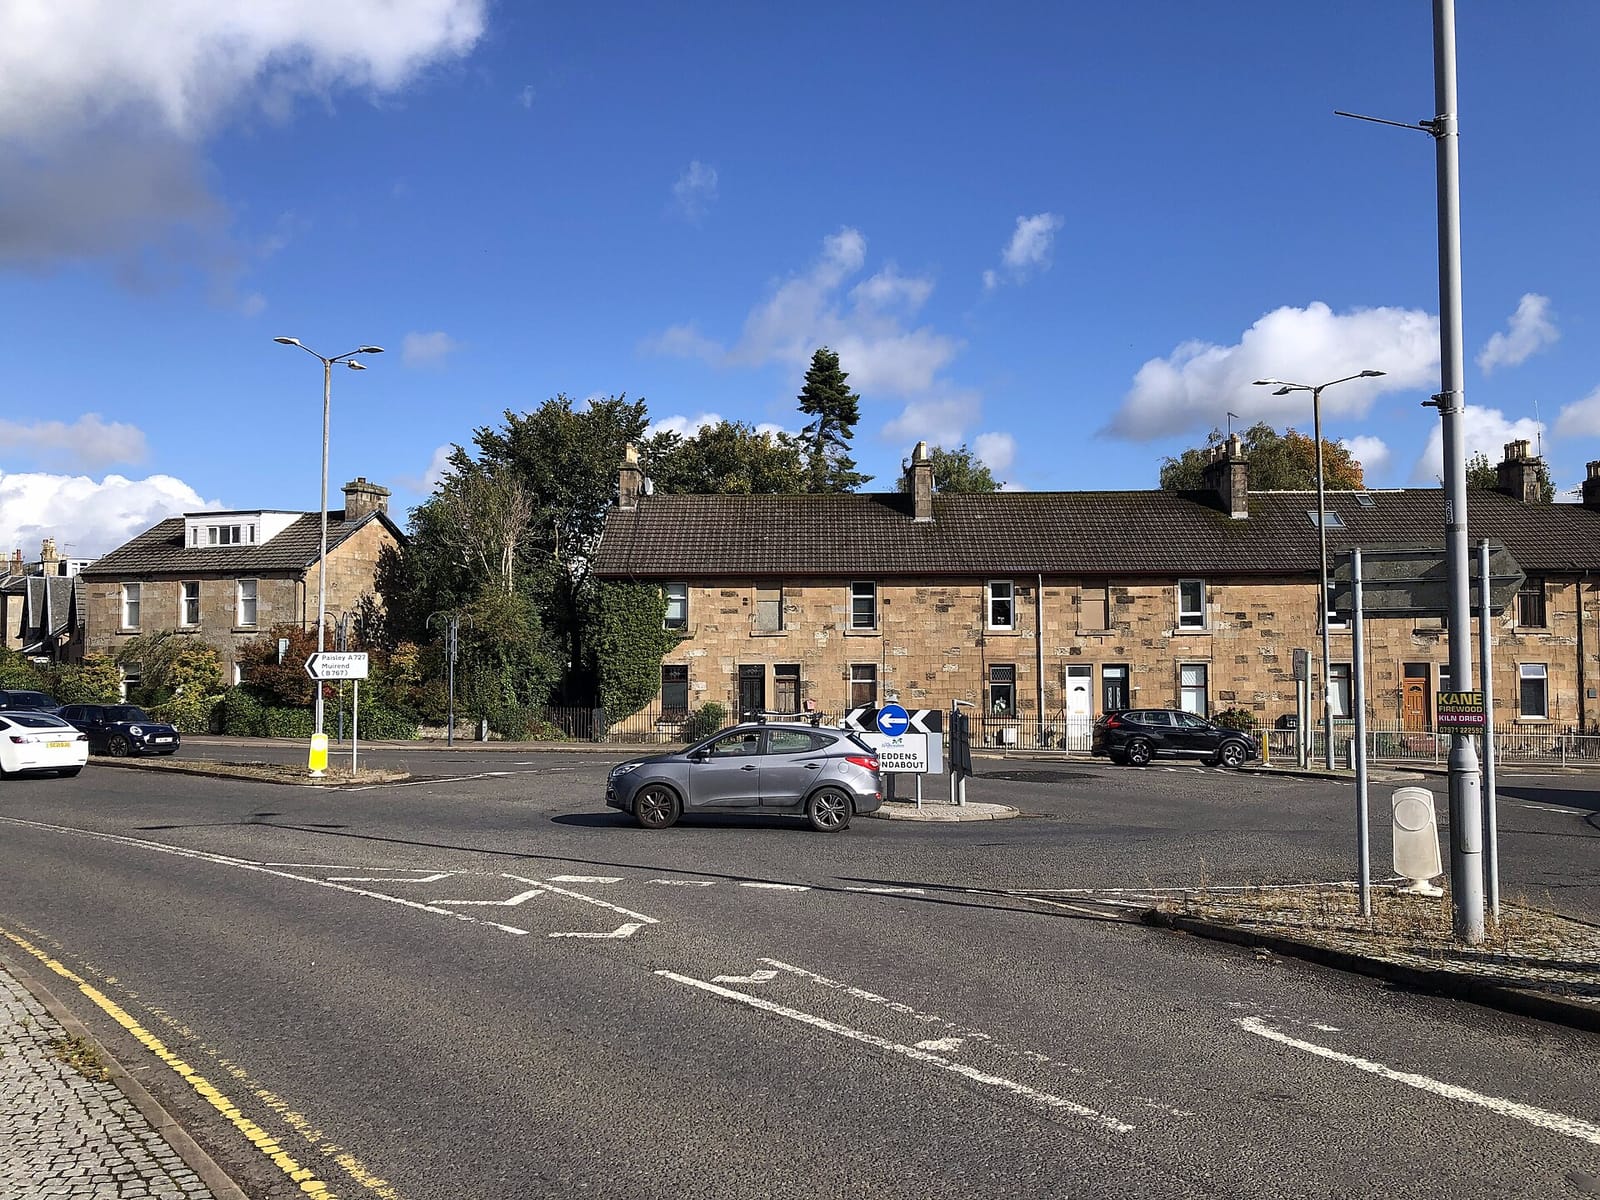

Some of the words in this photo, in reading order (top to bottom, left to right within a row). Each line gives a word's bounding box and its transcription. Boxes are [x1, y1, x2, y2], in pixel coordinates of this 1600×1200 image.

[321, 654, 345, 662] Paisley
[1438, 693, 1483, 705] KANE
[1438, 705, 1483, 713] FIREWOOD
[879, 752, 918, 761] EDDENS
[880, 761, 925, 769] NDABOUT
